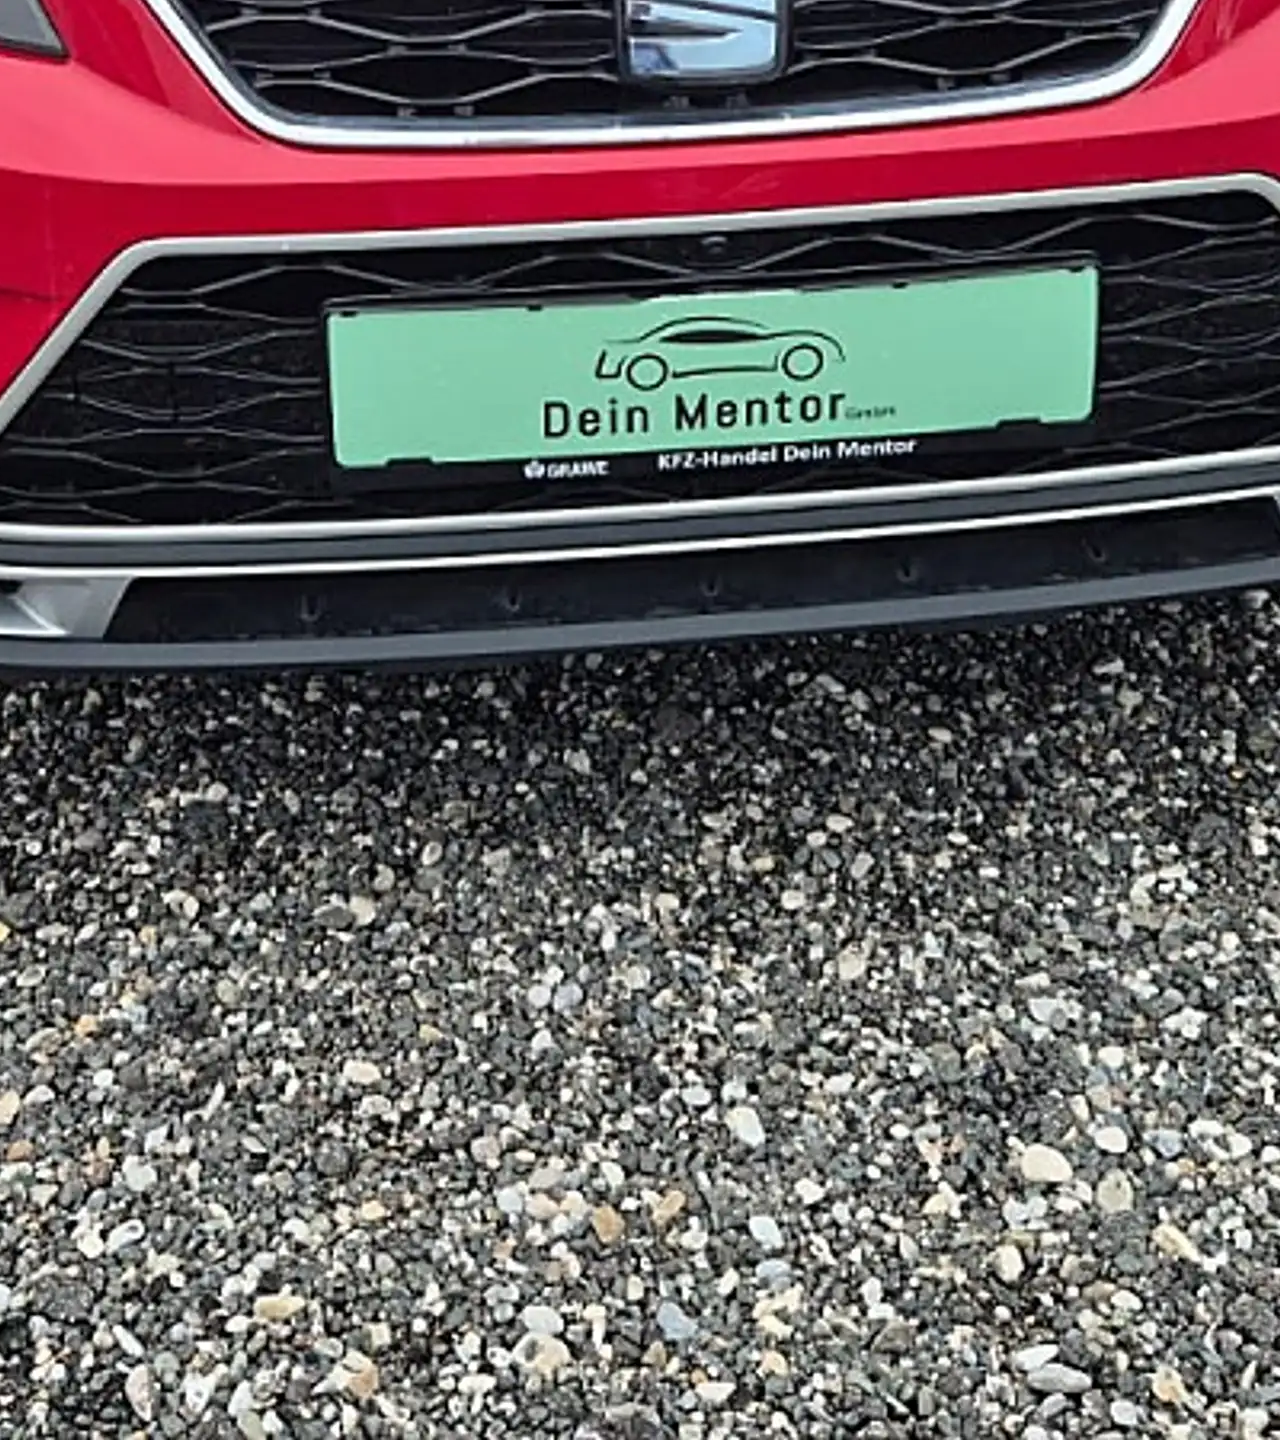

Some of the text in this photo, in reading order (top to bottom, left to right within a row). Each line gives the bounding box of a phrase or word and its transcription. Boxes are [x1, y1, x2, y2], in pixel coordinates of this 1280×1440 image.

[543, 397, 650, 439] Dein
[674, 390, 846, 431] Mentor
[657, 438, 918, 470] KFZ-Handel Dein Mentor
